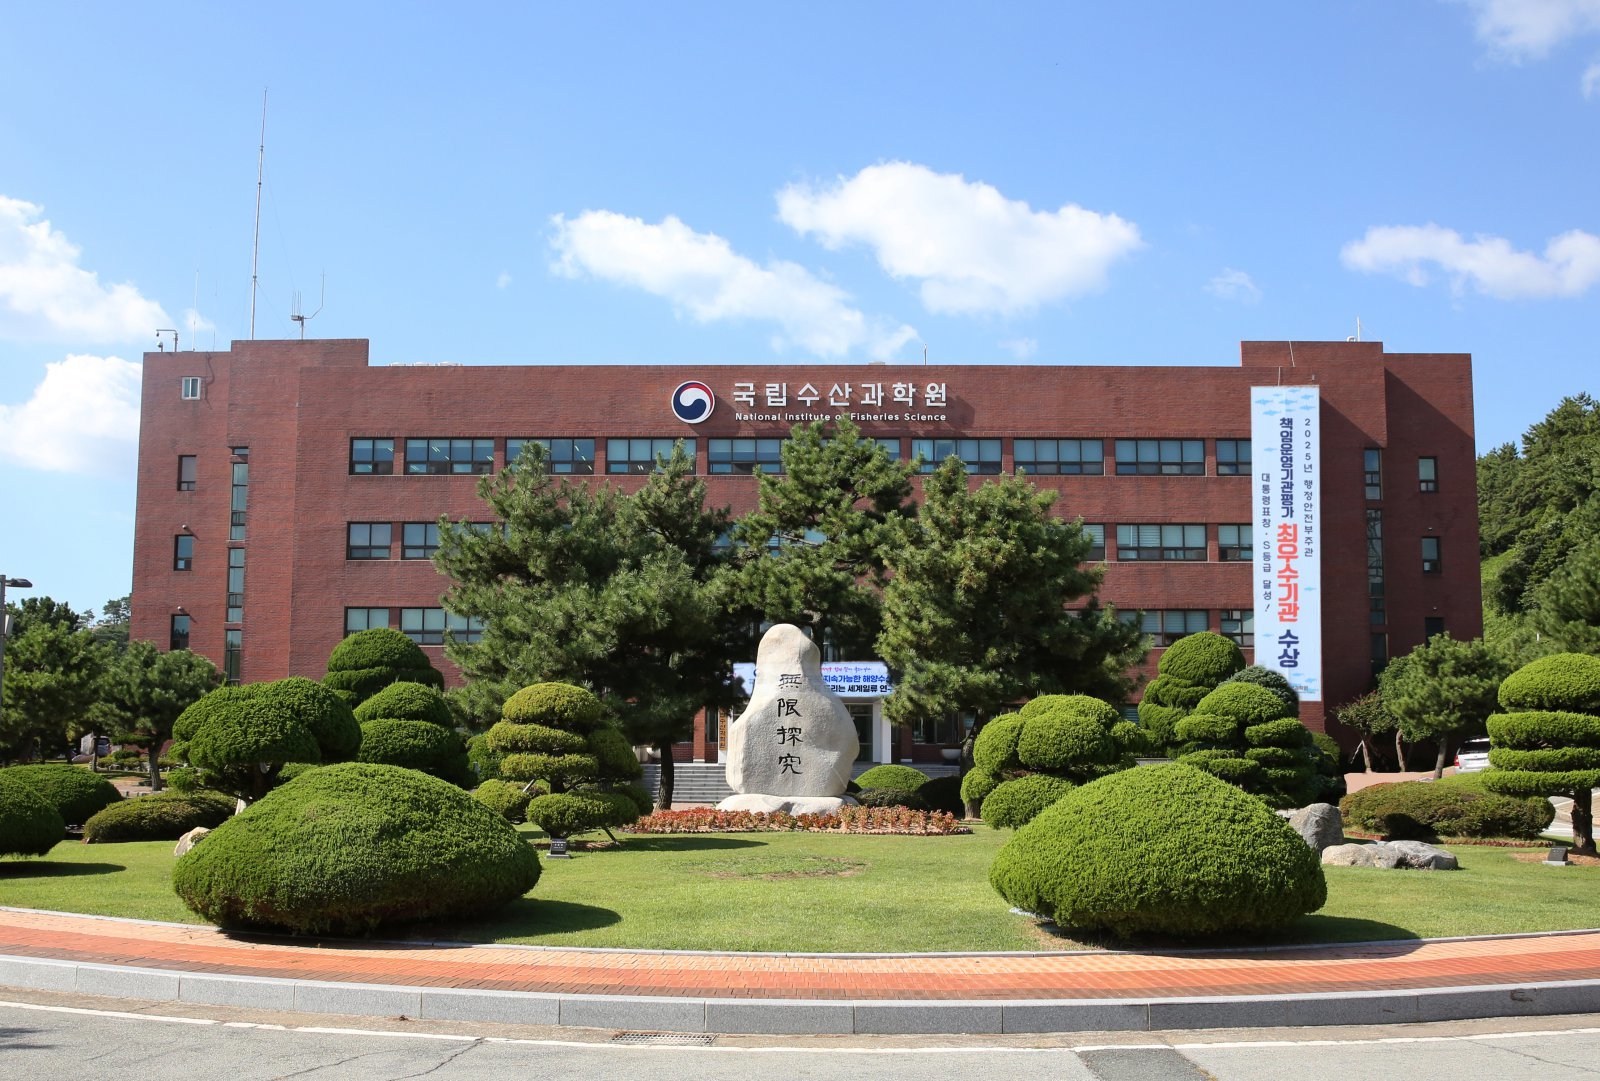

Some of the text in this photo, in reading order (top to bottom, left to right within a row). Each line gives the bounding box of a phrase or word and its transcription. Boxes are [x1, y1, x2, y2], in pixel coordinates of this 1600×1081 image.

[733, 382, 946, 406] 국립수산과학원
[735, 412, 946, 421] National Institute o Fisheries Science
[1304, 418, 1312, 473] 2025년
[1277, 417, 1300, 668] 책임운영기관평가 최우수기관 수상
[823, 675, 861, 683] 지속가능한
[847, 685, 878, 693] 세계일류
[776, 673, 804, 775] 無限探究
